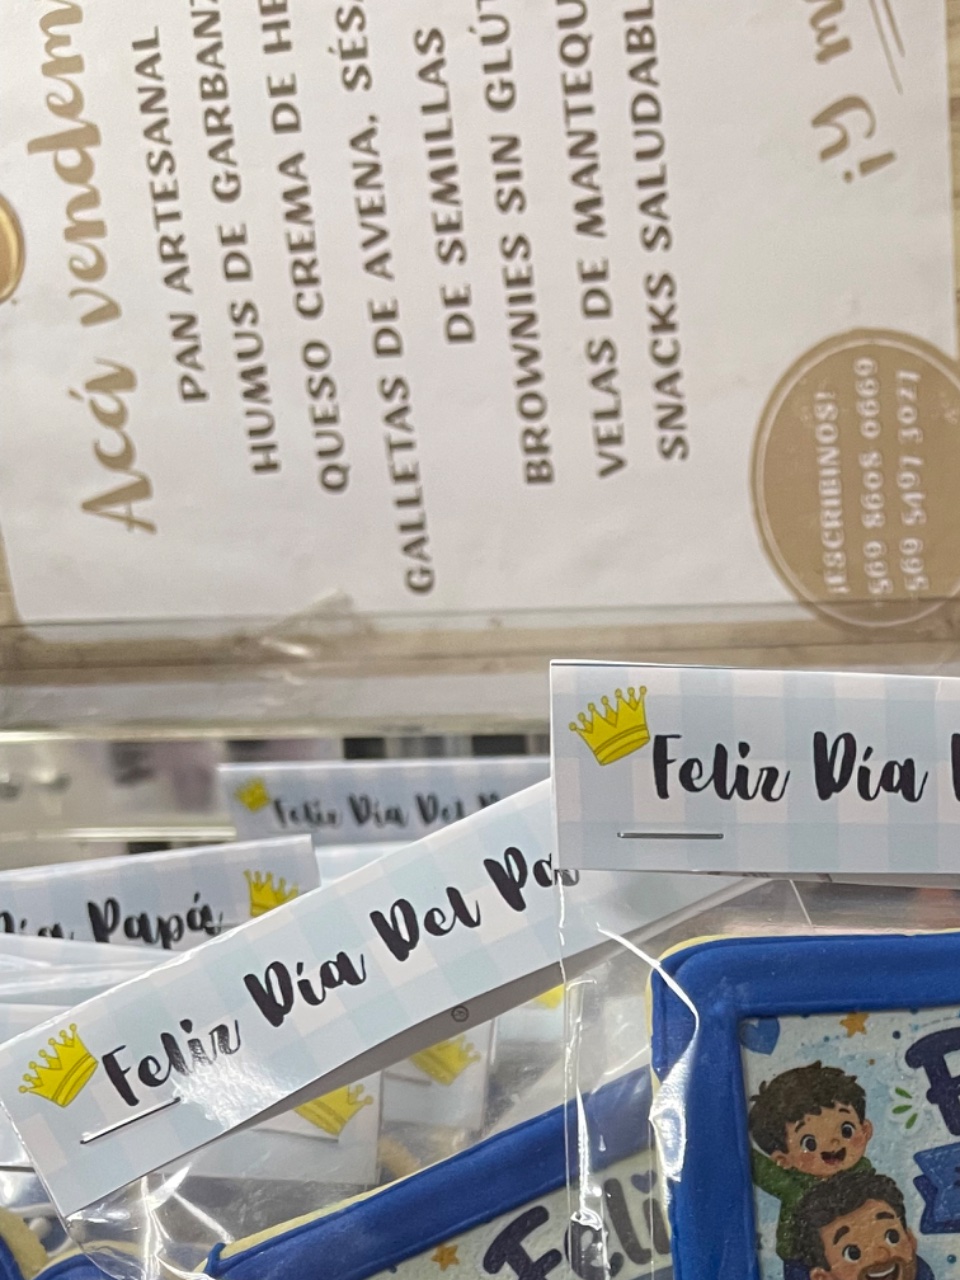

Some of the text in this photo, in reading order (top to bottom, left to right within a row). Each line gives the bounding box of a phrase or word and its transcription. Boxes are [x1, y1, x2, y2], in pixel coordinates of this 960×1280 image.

[266, 72, 303, 135] DE
[326, 0, 374, 93] SÉS
[131, 26, 209, 403] PAN ARTESANAL
[190, 0, 282, 474] HUMUS DE GARBAN
[277, 152, 324, 320] CREMA
[413, 26, 477, 344] DE SEMILLAS
[490, 133, 529, 214] SIN
[369, 297, 403, 359] DE
[500, 233, 555, 486] BROWNIES
[576, 256, 612, 319] DE
[643, 271, 690, 461] SNACKS
[68, 357, 157, 535] Acá
[301, 338, 350, 493] QUESO
[377, 375, 436, 594] GALLETAS
[583, 336, 628, 480] VELAS
[814, 389, 850, 595] ¡ESCRIBINOS!
[652, 733, 790, 800] Feliz
[812, 730, 928, 802] Día
[100, 1017, 242, 1106] Feliz
[242, 950, 367, 1028] Día
[369, 884, 483, 962] Del
